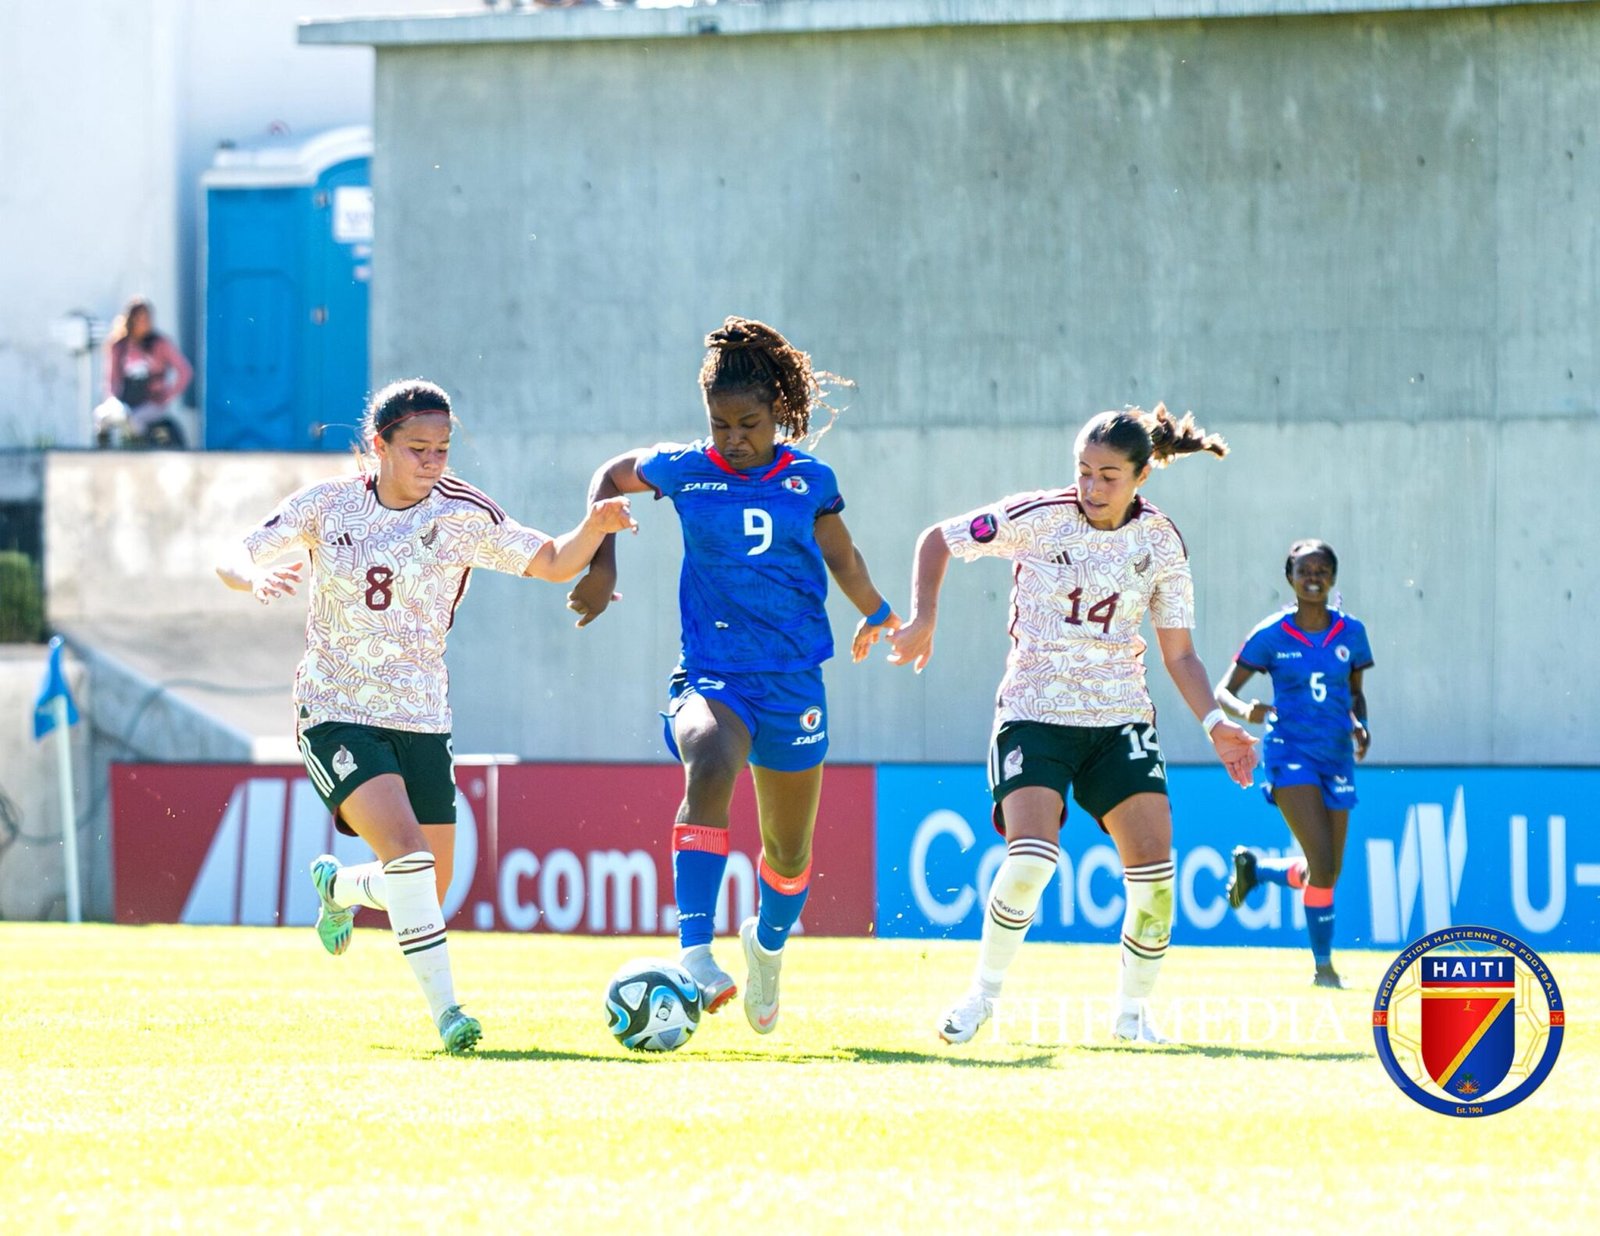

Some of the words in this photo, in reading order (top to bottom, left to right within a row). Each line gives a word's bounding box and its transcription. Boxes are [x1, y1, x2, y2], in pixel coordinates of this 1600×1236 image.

[681, 482, 728, 492] SAETA
[743, 508, 773, 556] 9
[365, 566, 393, 611] 8
[1065, 587, 1120, 634] 14
[909, 809, 1307, 932] Cncca
